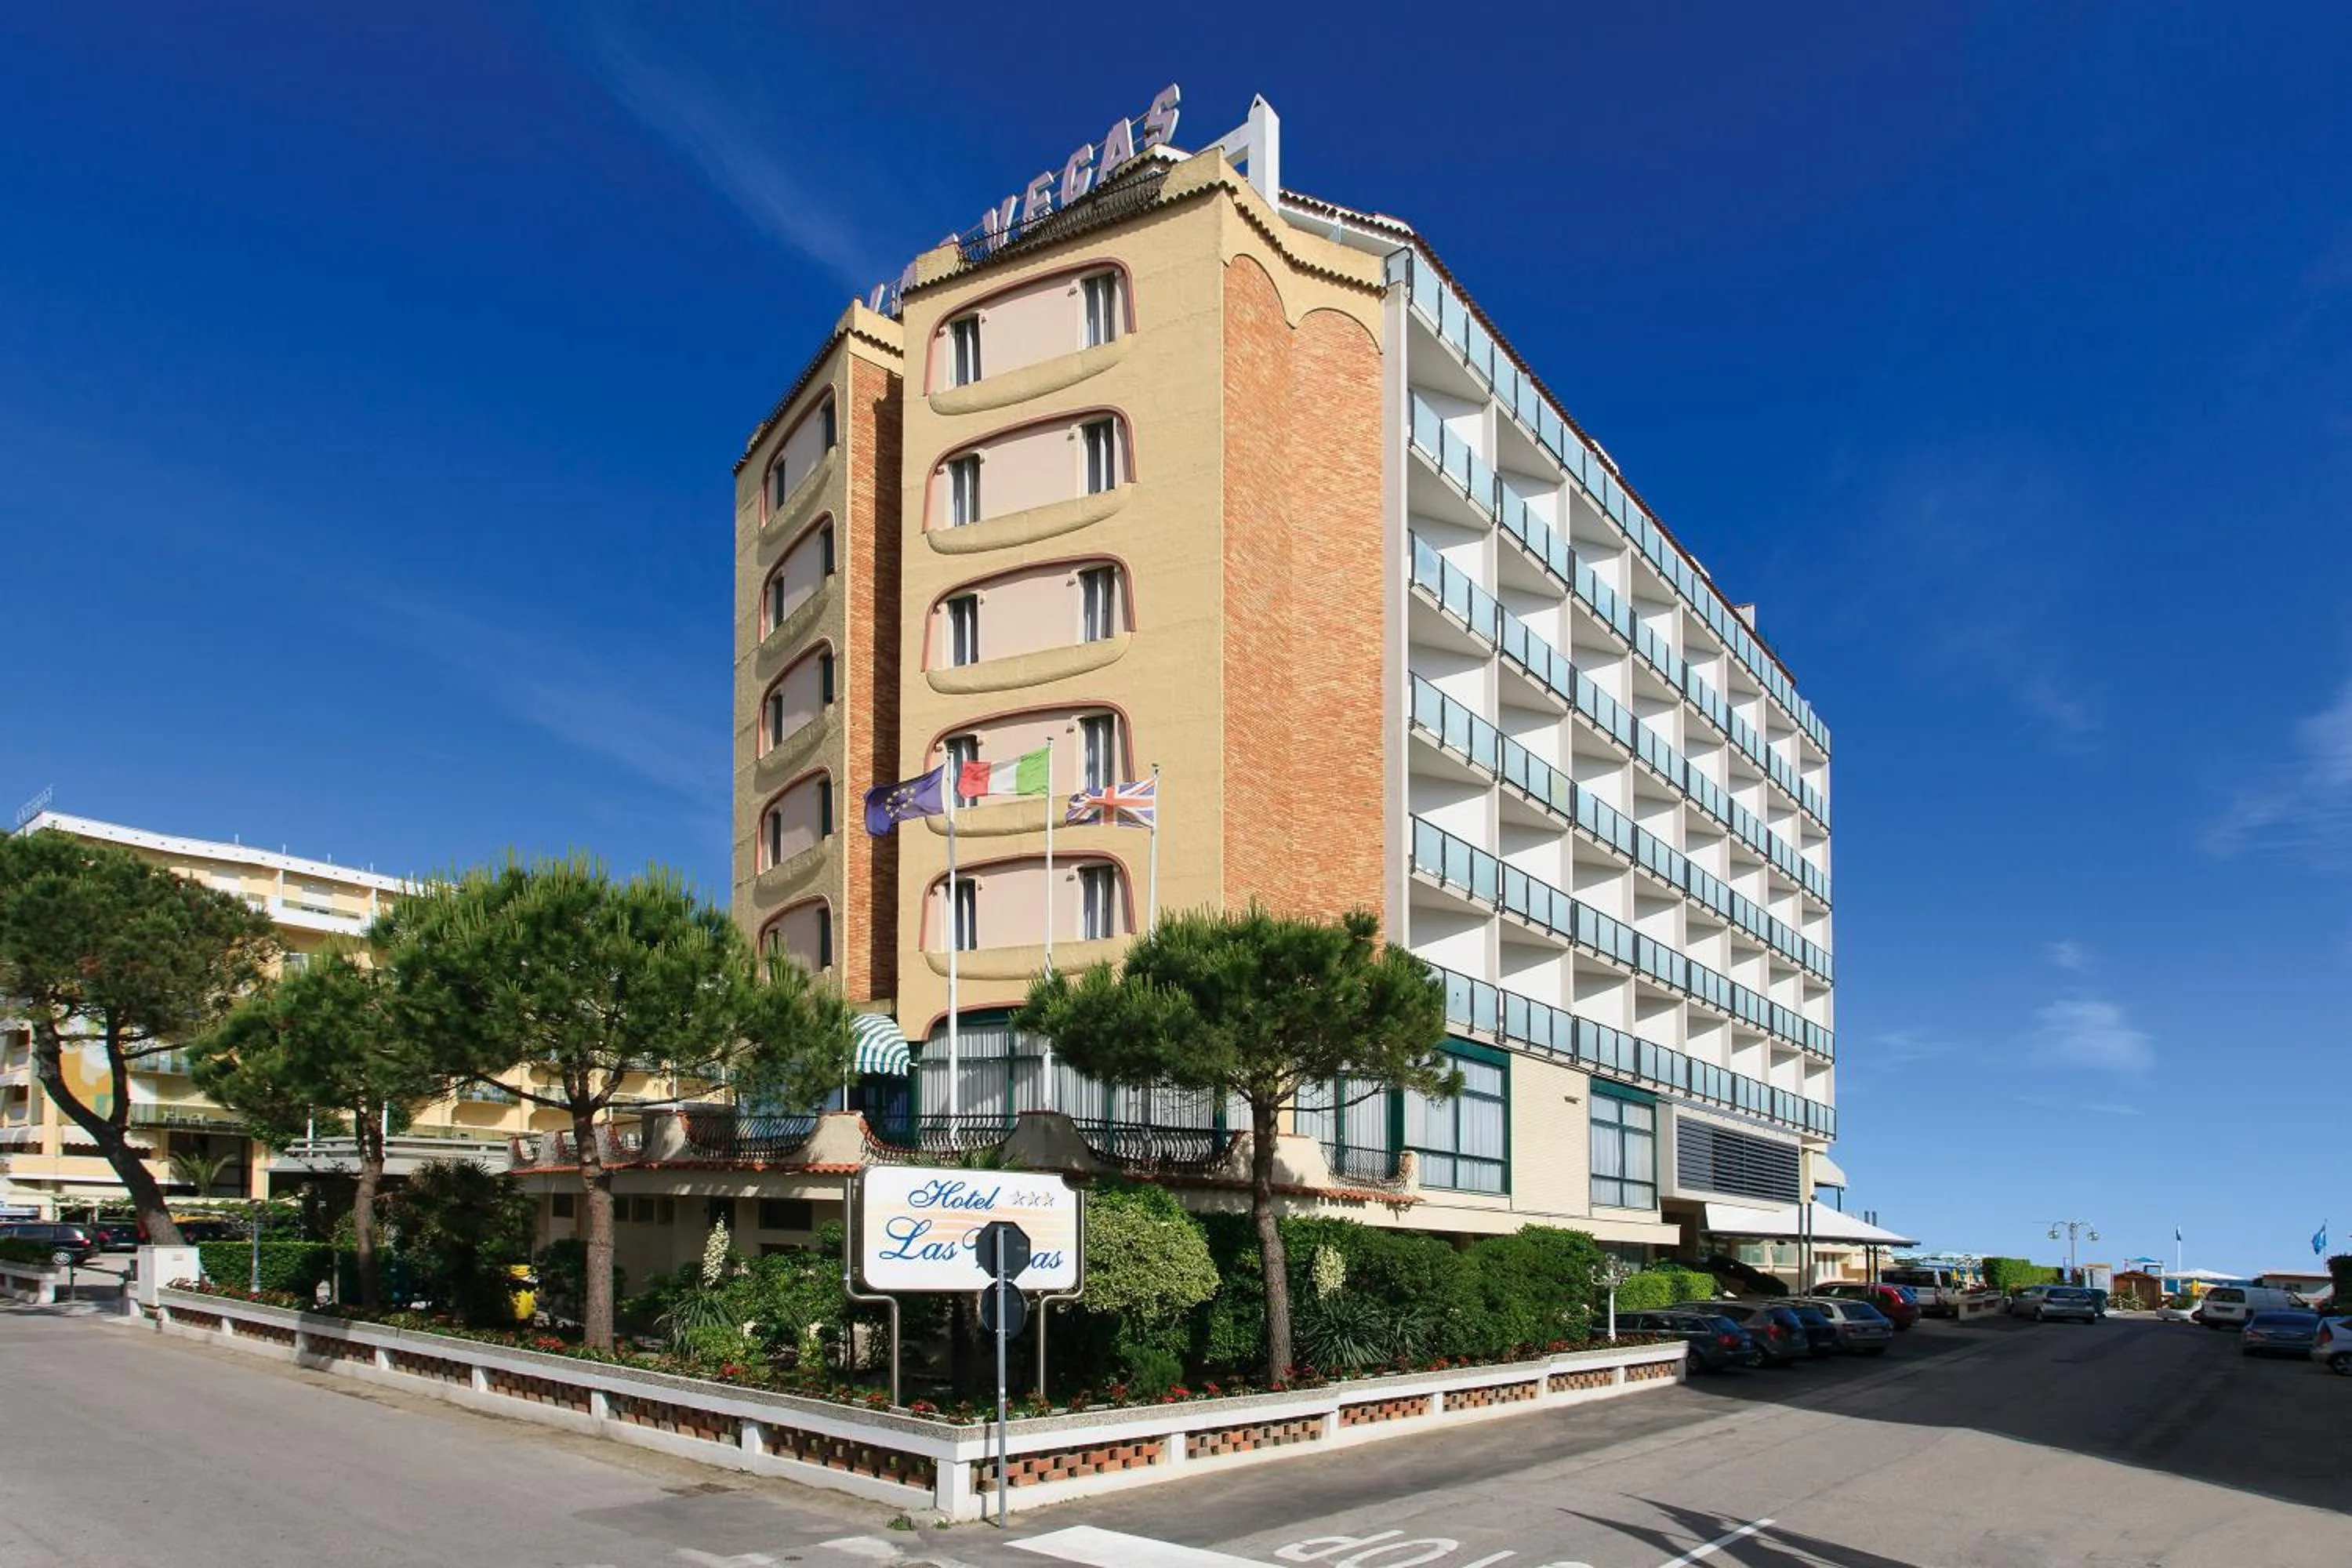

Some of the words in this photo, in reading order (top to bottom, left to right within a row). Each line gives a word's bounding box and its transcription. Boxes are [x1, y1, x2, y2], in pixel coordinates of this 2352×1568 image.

[982, 82, 1181, 252] VEGAS
[907, 1179, 1001, 1210] Hotel
[879, 1216, 958, 1261] Las
